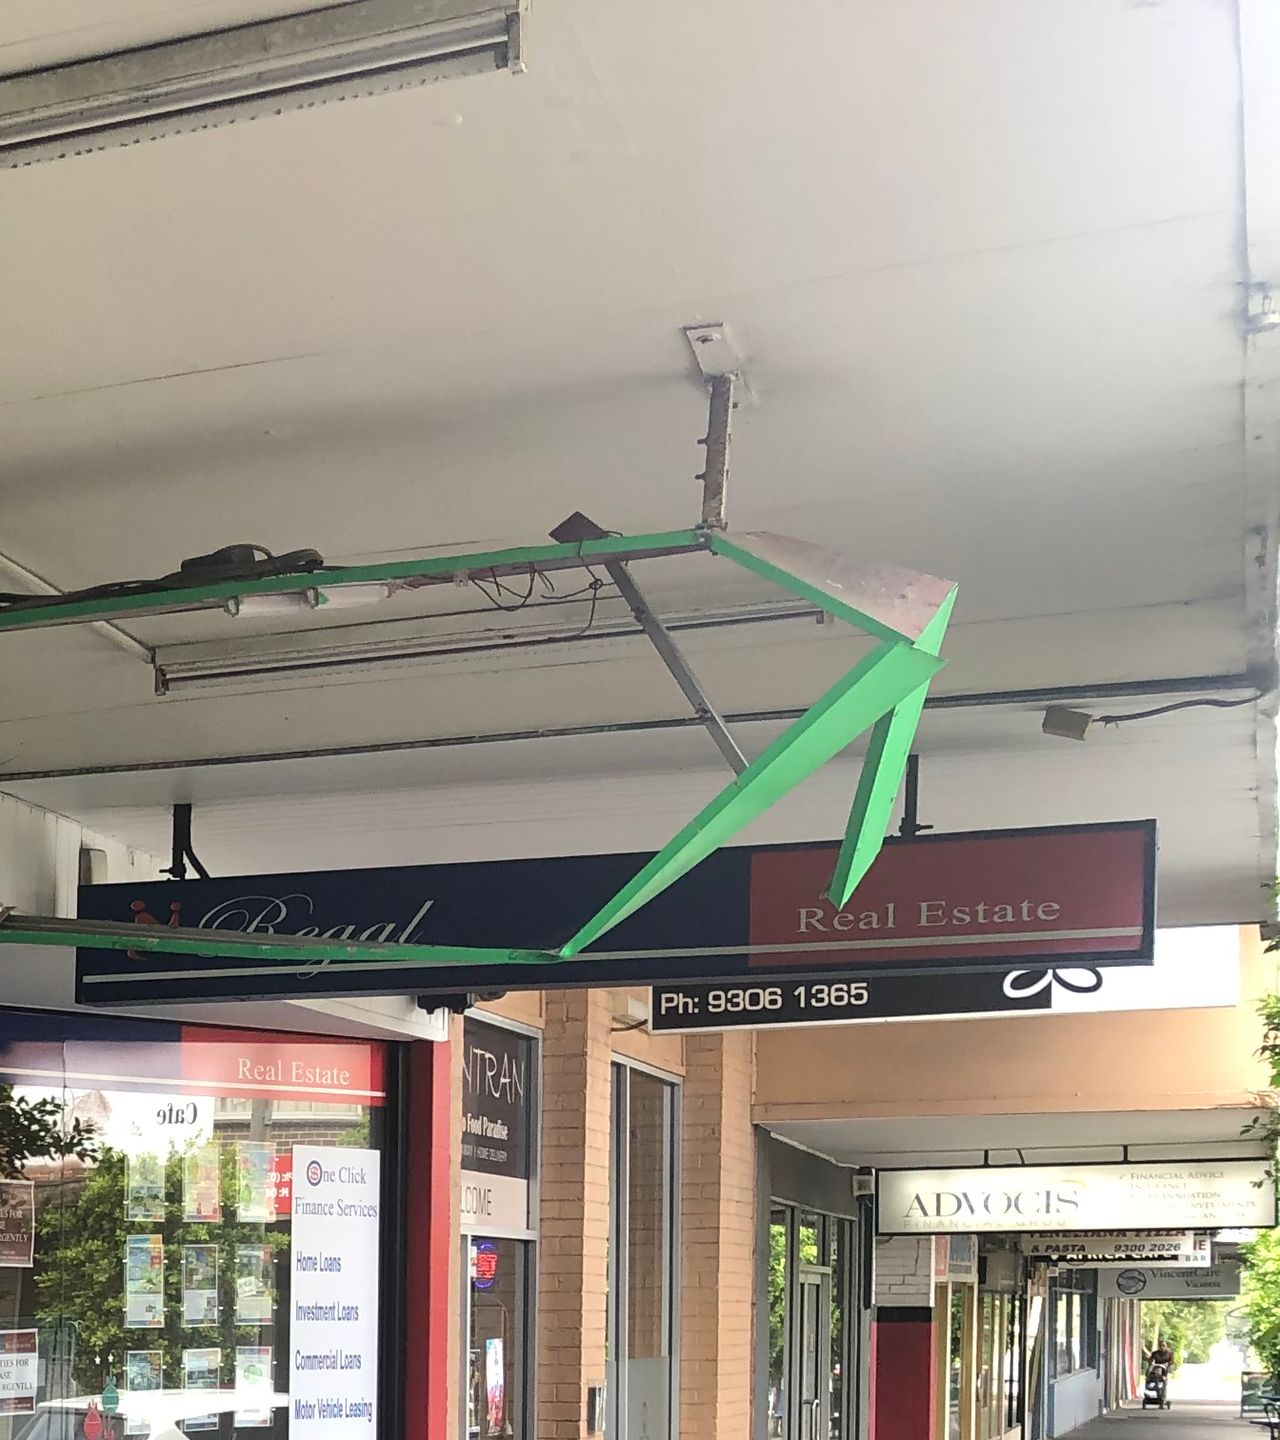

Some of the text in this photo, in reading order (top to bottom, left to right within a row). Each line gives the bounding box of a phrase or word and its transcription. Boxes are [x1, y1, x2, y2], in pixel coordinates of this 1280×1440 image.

[796, 899, 1061, 934] Real Estate
[659, 982, 869, 1016] Ph: 9306 1365
[238, 1057, 351, 1086] Real Estate
[339, 1166, 367, 1185] Click
[9, 1209, 23, 1219] FOR
[295, 1196, 378, 1218] Finance Services
[902, 1189, 1080, 1218] ADVOCIS
[1045, 1244, 1086, 1253] PASTA
[1149, 1242, 1181, 1252] 2026
[296, 1250, 342, 1273] Home Loans
[295, 1299, 359, 1321] Investment Loans
[15, 1358, 29, 1368] FOR
[295, 1348, 362, 1371] Commercial Loans
[294, 1396, 372, 1423] Motor Vehicle Leasing
